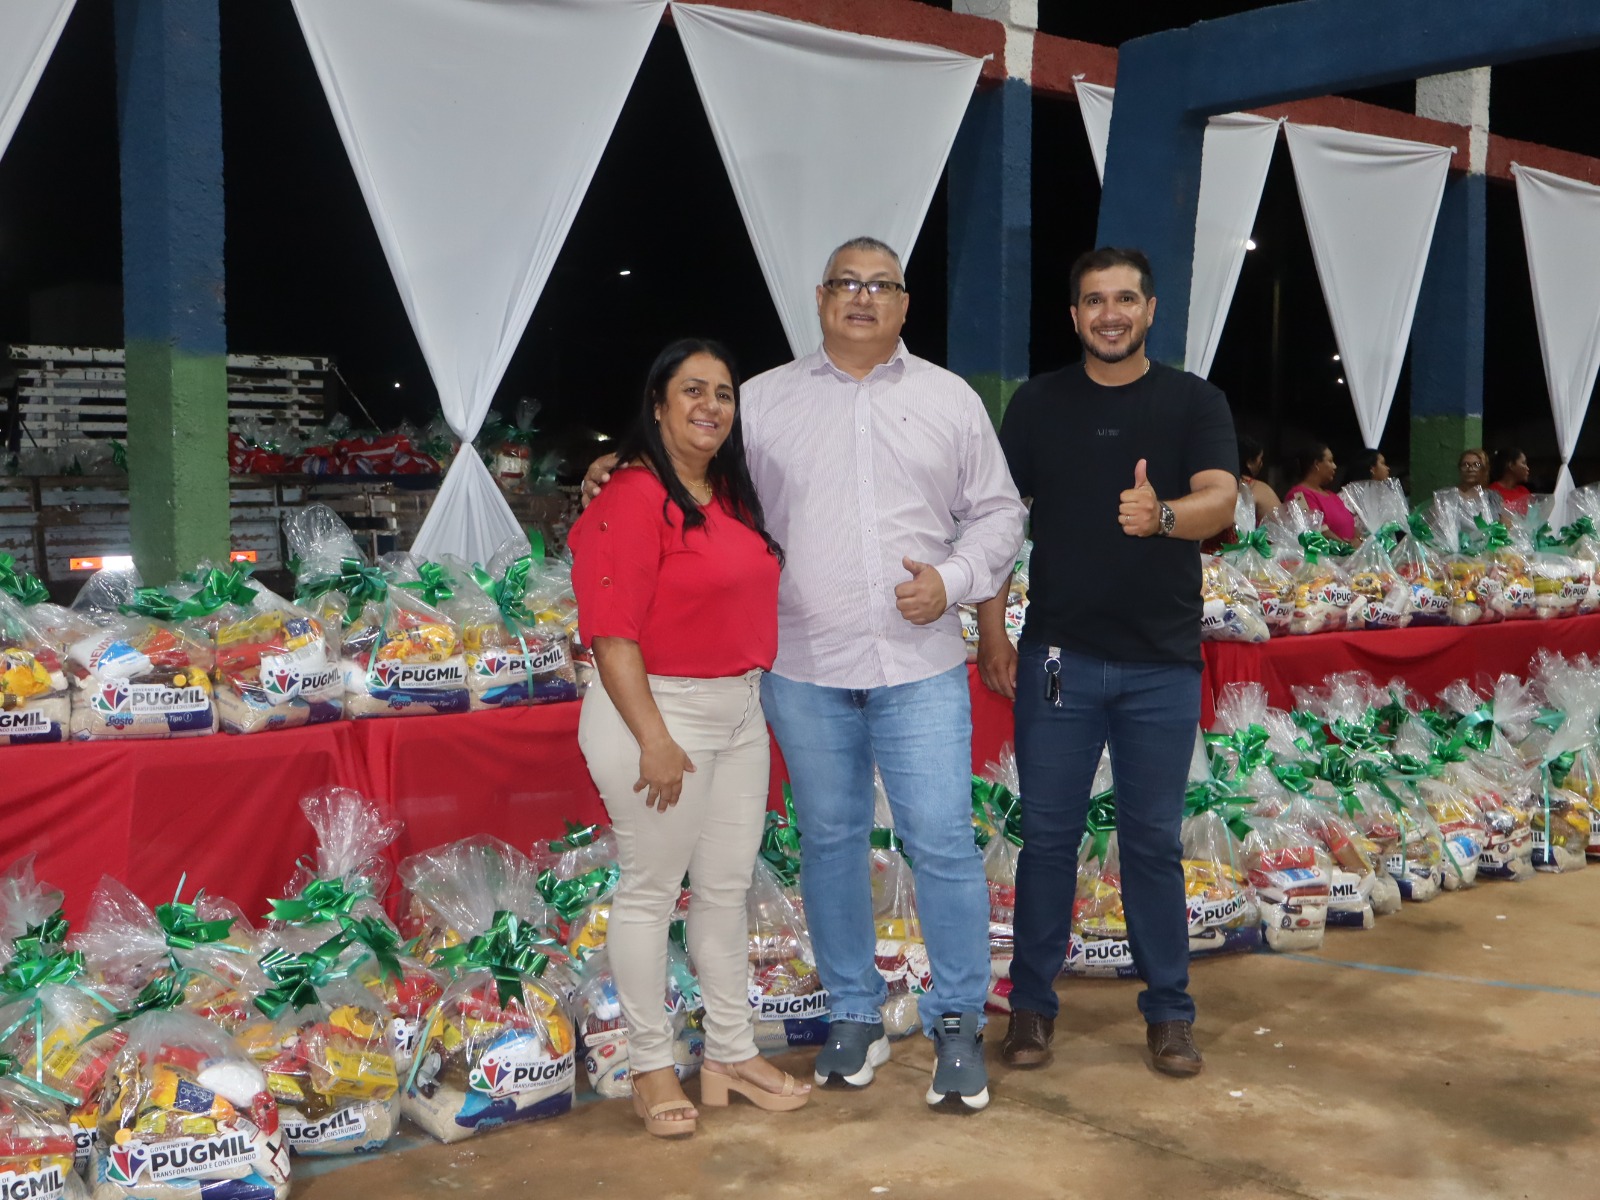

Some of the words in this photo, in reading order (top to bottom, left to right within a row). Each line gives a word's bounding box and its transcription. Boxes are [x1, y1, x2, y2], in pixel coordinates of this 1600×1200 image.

[302, 668, 341, 690] PUGMIL
[402, 667, 462, 682] PUGMIL
[132, 690, 205, 706] PUGMIL
[324, 1124, 361, 1138] CONSTRUINDO
[150, 1143, 179, 1153] GOVERNO
[151, 1135, 254, 1172] PUGMIL
[153, 1165, 207, 1179] TRANSFORMANDO
[214, 1153, 257, 1168] CONSTRUINDO
